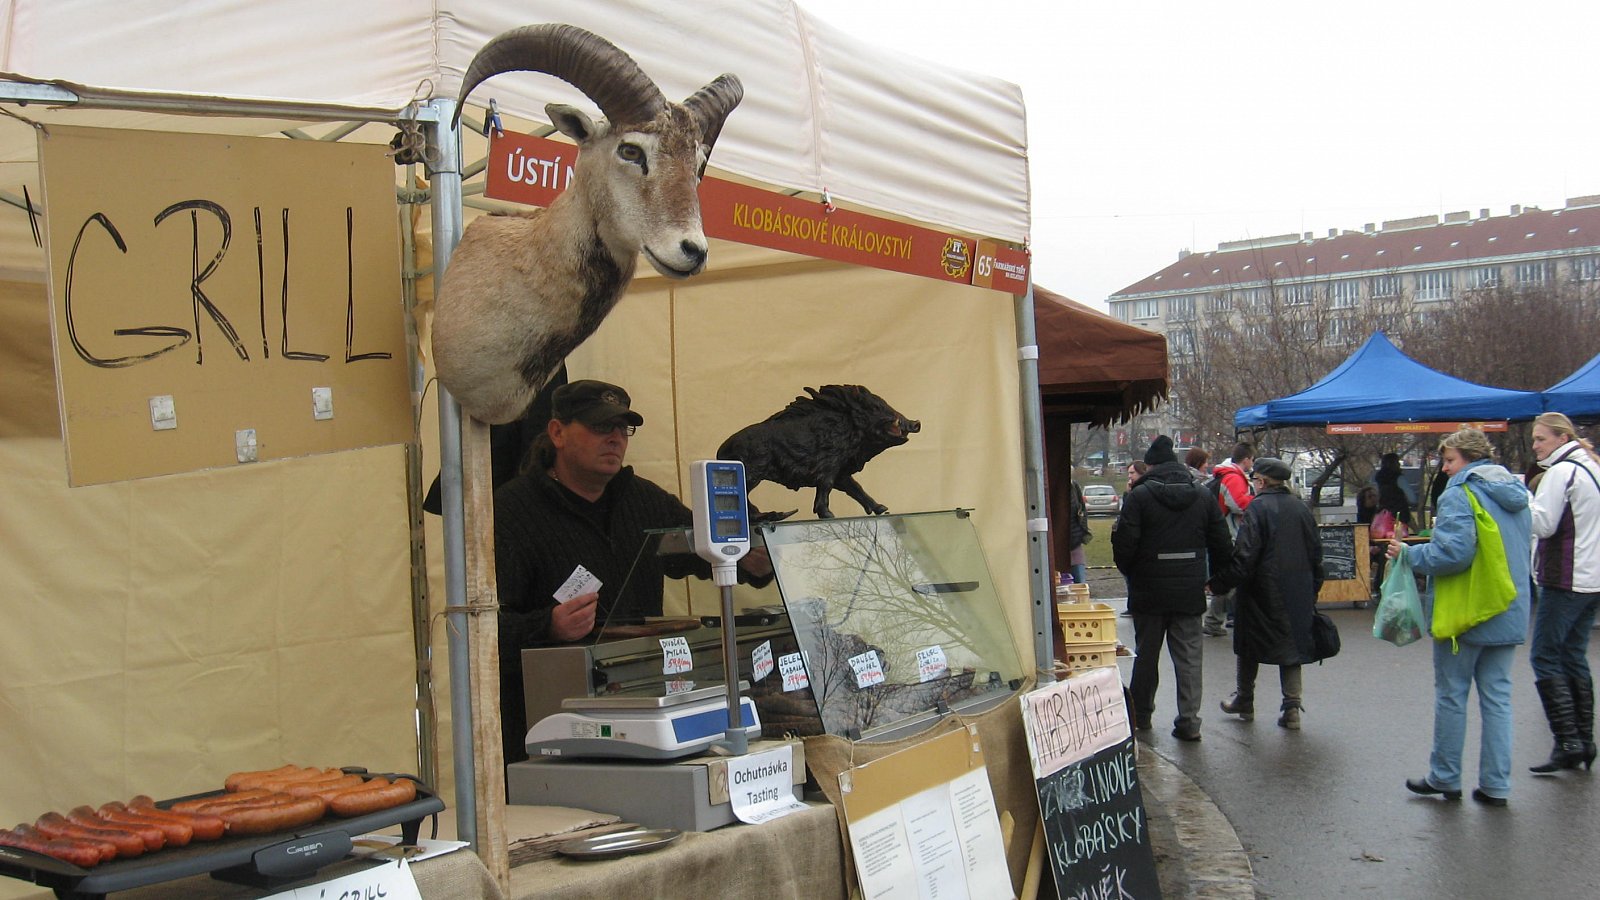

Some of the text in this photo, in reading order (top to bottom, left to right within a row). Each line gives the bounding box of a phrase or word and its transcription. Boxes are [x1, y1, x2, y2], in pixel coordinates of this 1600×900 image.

[507, 147, 561, 190] ÚSTÍ
[733, 202, 913, 260] KLOBÁSKOVÉ KRÁLOVSTVÍ
[65, 199, 391, 368] GRILL
[978, 255, 992, 277] 65
[734, 760, 788, 785] Ochutnávka
[747, 787, 779, 806] Tasting
[1054, 806, 1142, 876] KLOBÁSKY
